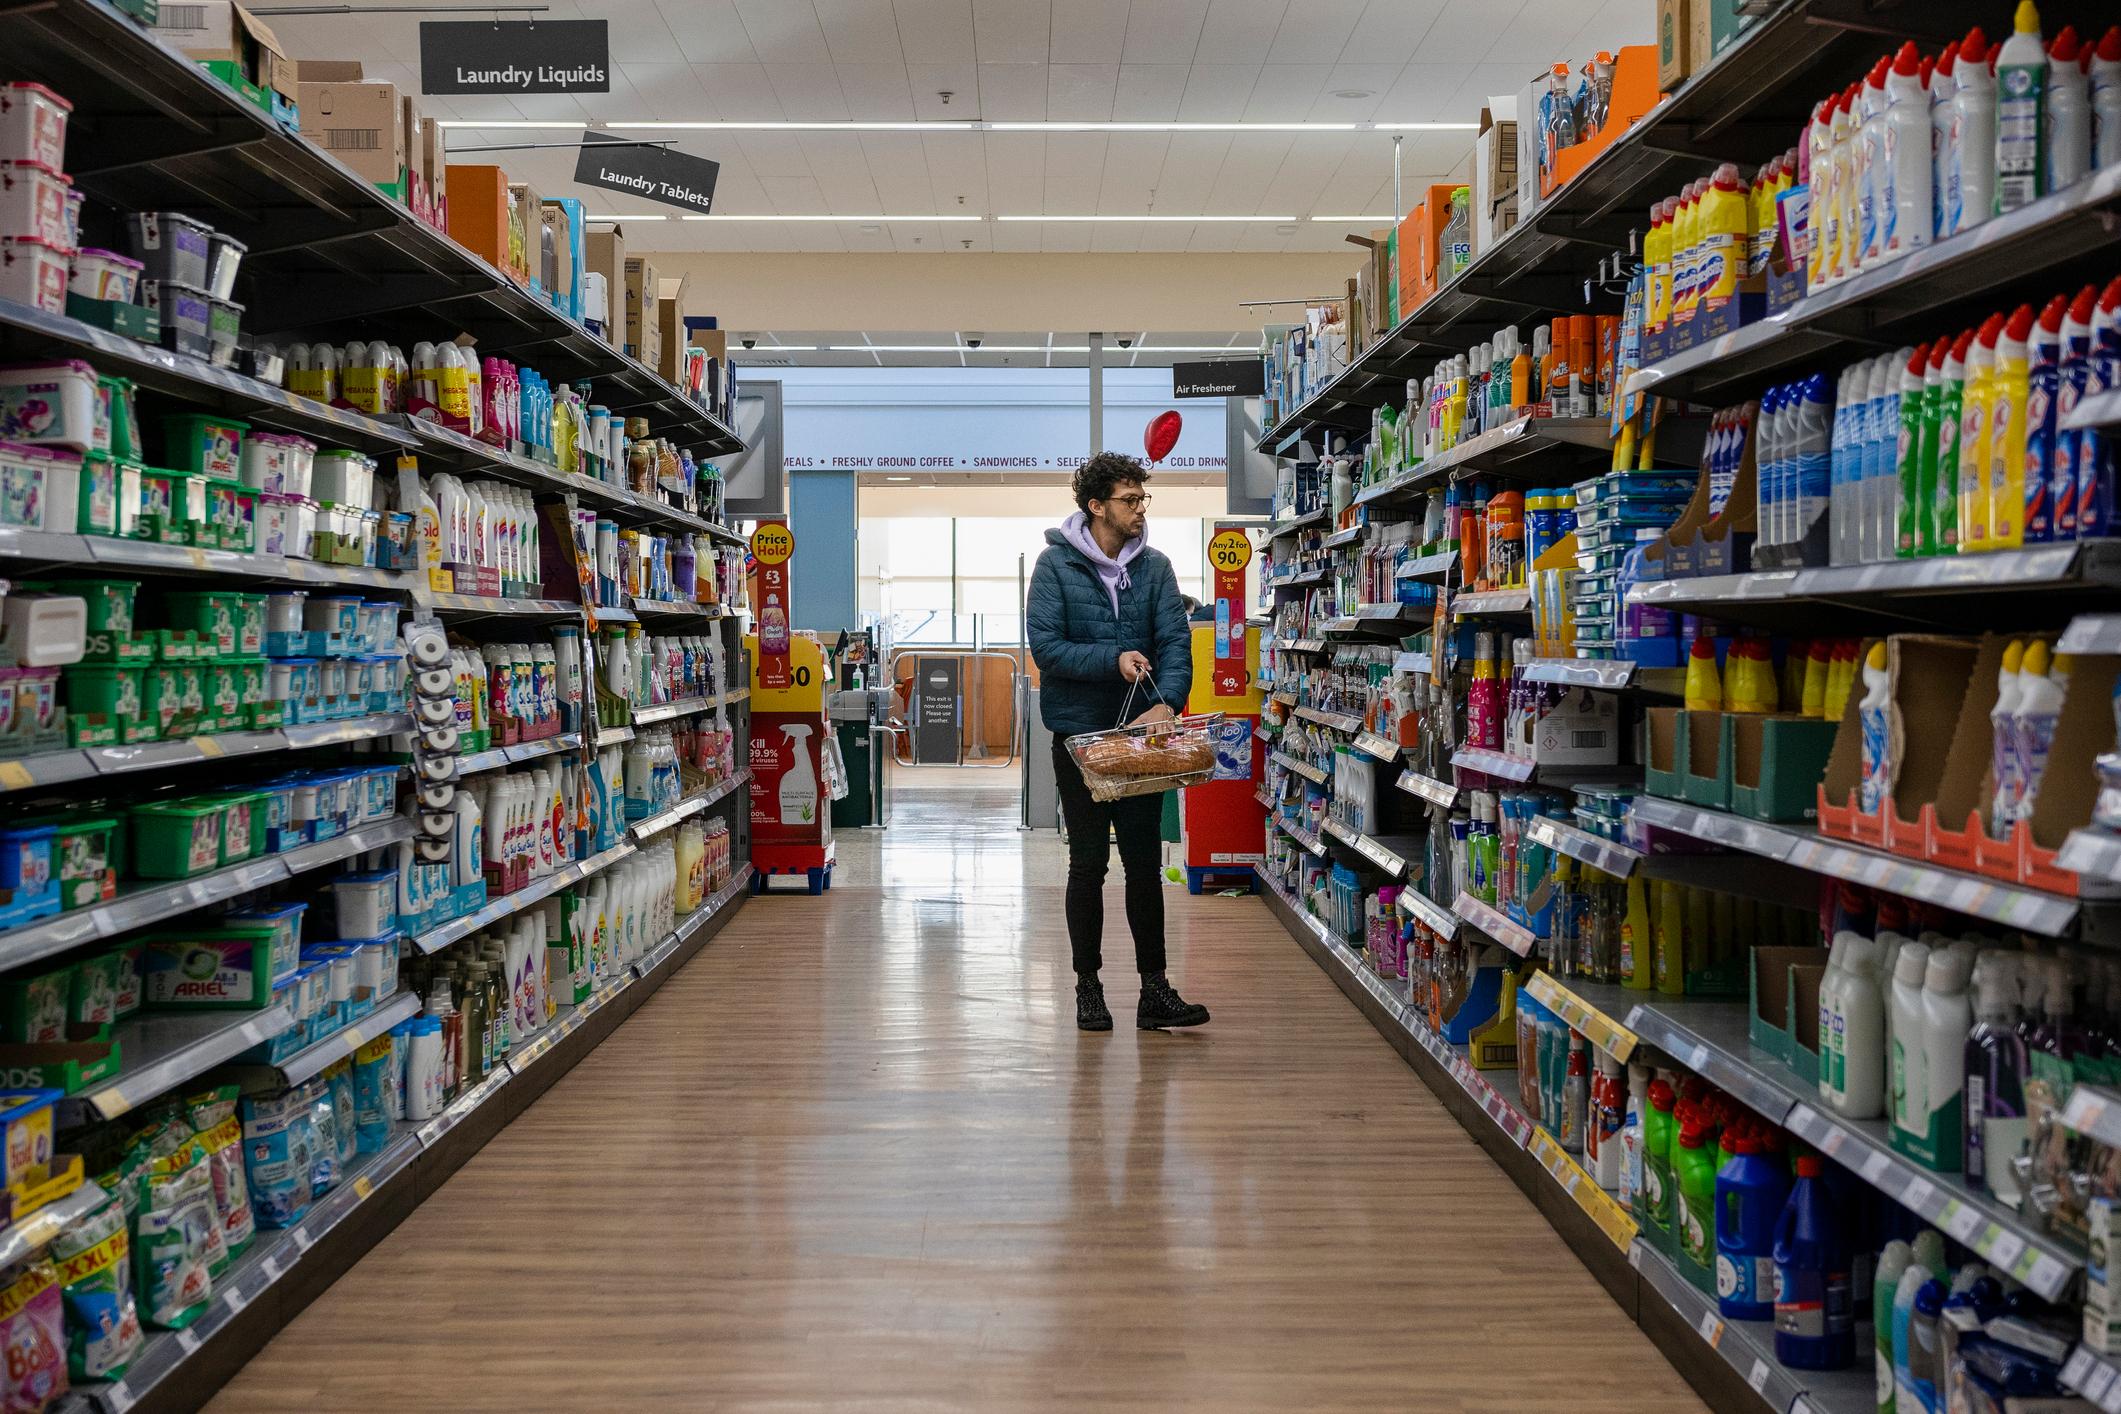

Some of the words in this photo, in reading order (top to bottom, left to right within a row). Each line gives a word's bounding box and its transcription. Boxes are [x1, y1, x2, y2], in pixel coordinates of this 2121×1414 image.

[456, 66, 533, 88] Laundry
[538, 64, 605, 87] Liquids
[600, 167, 656, 194] Laundry
[660, 181, 710, 207] Tablets
[1176, 385, 1190, 394] Air
[1191, 383, 1237, 394] Freshener
[832, 456, 874, 467] FRESHLY
[877, 456, 916, 467] GROUND
[919, 456, 954, 467] COFFEE
[973, 457, 1037, 467] SANDWICHES
[1170, 457, 1197, 467] COLD
[757, 533, 788, 545] Price
[1212, 541, 1227, 550] Any
[1228, 538, 1235, 549] 2
[1236, 540, 1247, 549] for
[757, 544, 788, 556] Hold
[1217, 551, 1243, 566] 90p
[765, 570, 780, 584] £3
[1222, 575, 1239, 583] Save
[1222, 677, 1238, 688] 49p
[174, 982, 229, 996] ARIEL
[64, 1250, 108, 1281] XXL
